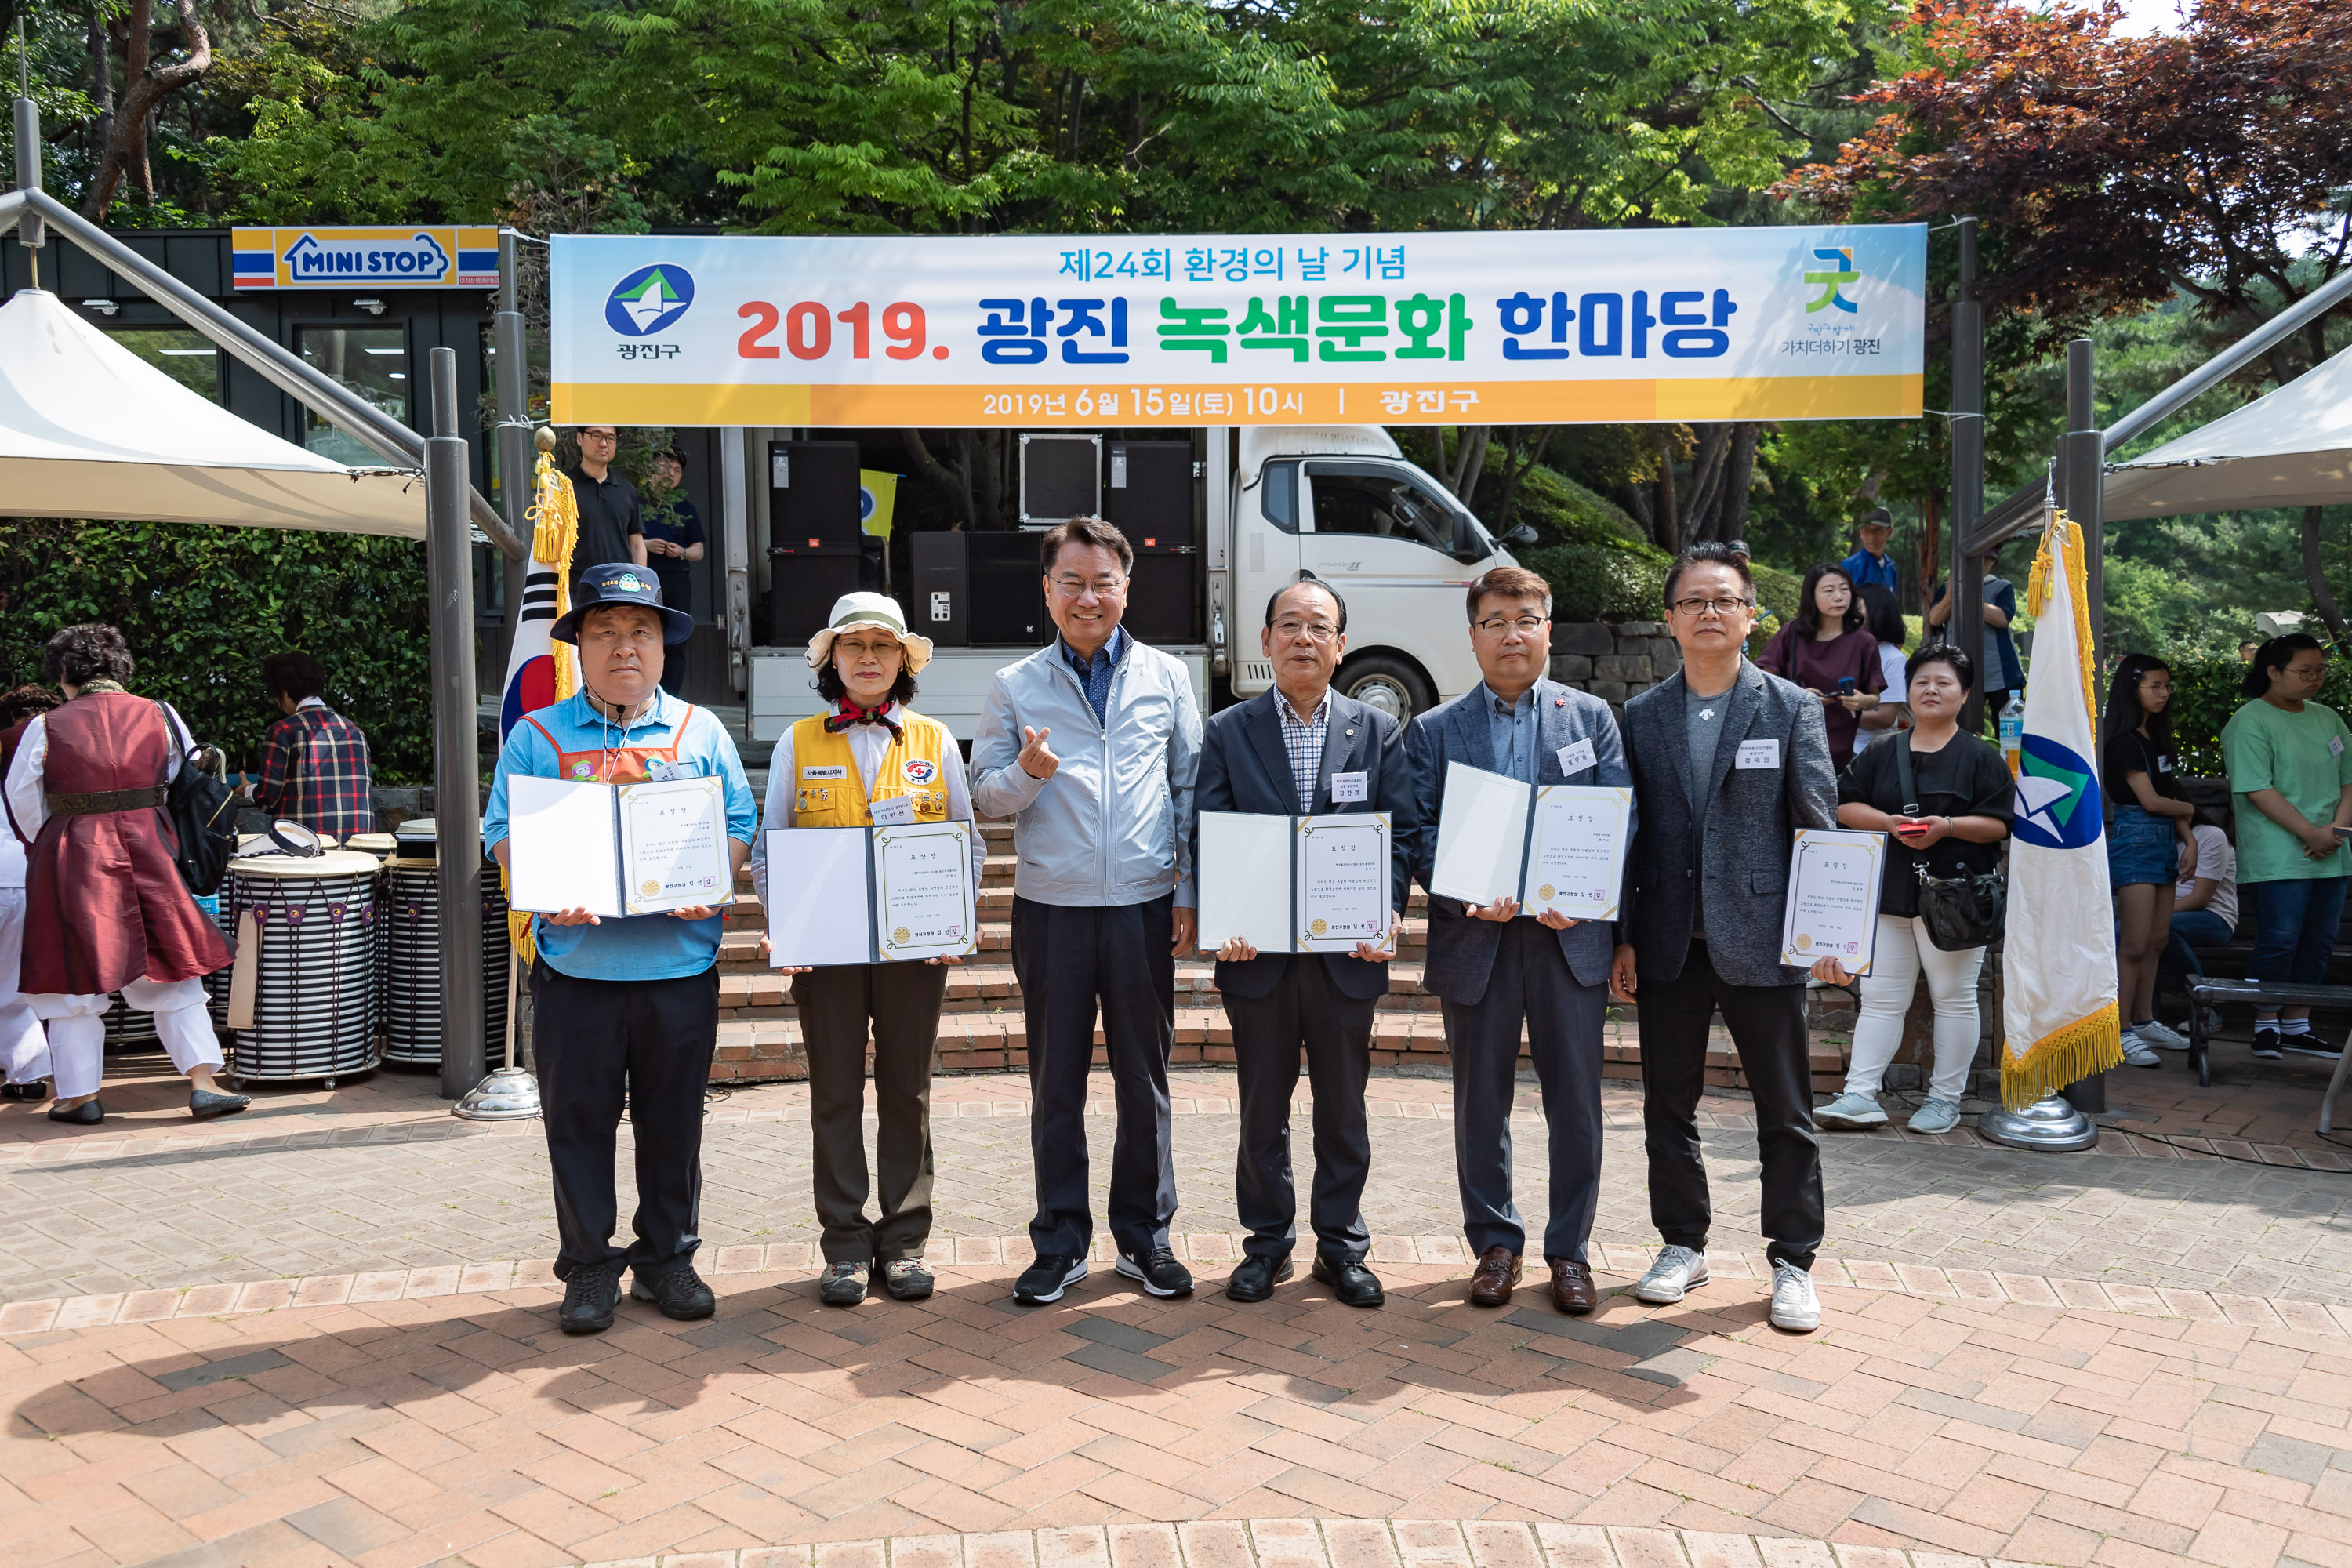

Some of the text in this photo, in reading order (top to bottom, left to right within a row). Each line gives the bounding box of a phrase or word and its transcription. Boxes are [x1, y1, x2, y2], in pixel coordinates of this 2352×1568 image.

[303, 251, 434, 273] MINI STOP
[1060, 245, 1406, 282] 제24회 환경의 날 기념
[738, 289, 1737, 364] 2019. 광진 녹색문화 한마당
[617, 344, 681, 360] 광진구
[1781, 339, 1880, 356] 가치더하기 광진
[985, 388, 1479, 416] 2019년 6월 15일(토) 10시 광진구
